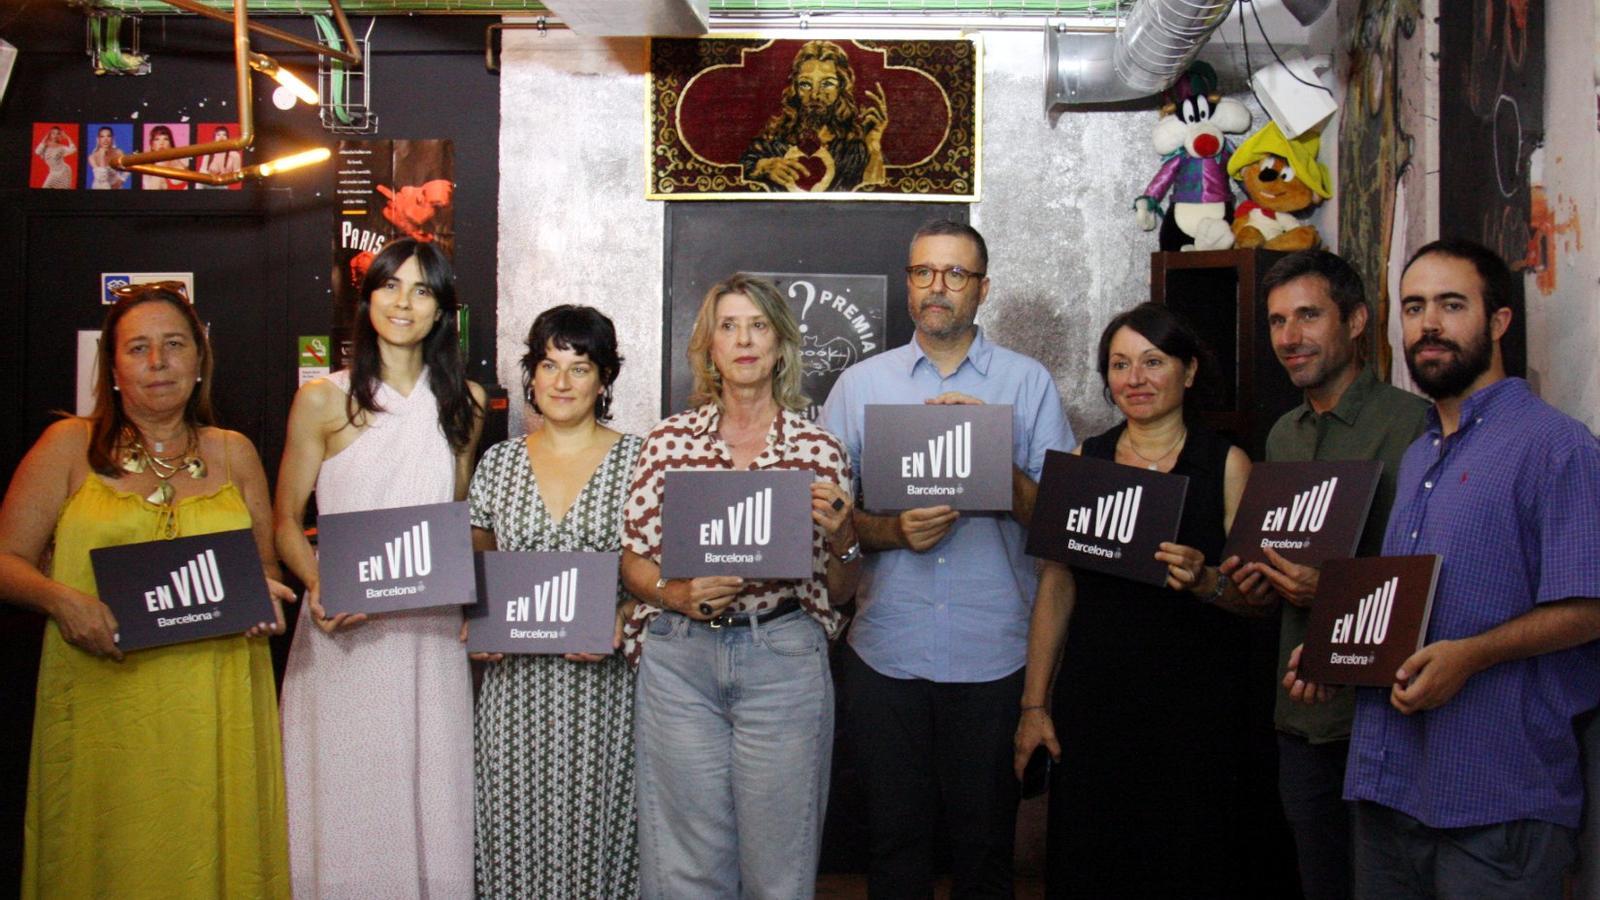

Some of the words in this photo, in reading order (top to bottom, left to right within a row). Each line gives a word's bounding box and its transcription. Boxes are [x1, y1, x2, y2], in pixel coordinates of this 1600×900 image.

[341, 221, 385, 255] PARIS
[819, 290, 877, 353] PREMIA
[902, 452, 925, 478] EN
[928, 421, 972, 478] VIU
[907, 484, 956, 495] Barcelona
[1261, 506, 1288, 532] EN
[1287, 476, 1339, 533] VIU
[700, 519, 724, 546] EN
[728, 487, 773, 546] VIU
[1066, 506, 1092, 535] EN
[1094, 485, 1143, 544] VIU
[359, 555, 384, 583] EN
[385, 520, 432, 580] VIU
[705, 552, 754, 563] Barcelona
[1067, 538, 1114, 559] Barcelona
[1260, 538, 1303, 552] Barcelona
[145, 584, 174, 613] EN
[171, 548, 225, 607] VIU
[365, 585, 417, 599] Barcelona
[506, 596, 530, 622] EN
[535, 567, 578, 623] VIU
[157, 612, 213, 628] Barcelona
[1331, 613, 1355, 644] EN
[1354, 576, 1399, 645] VIU
[510, 628, 558, 639] Barcelona
[1330, 652, 1369, 665] Barcelona
